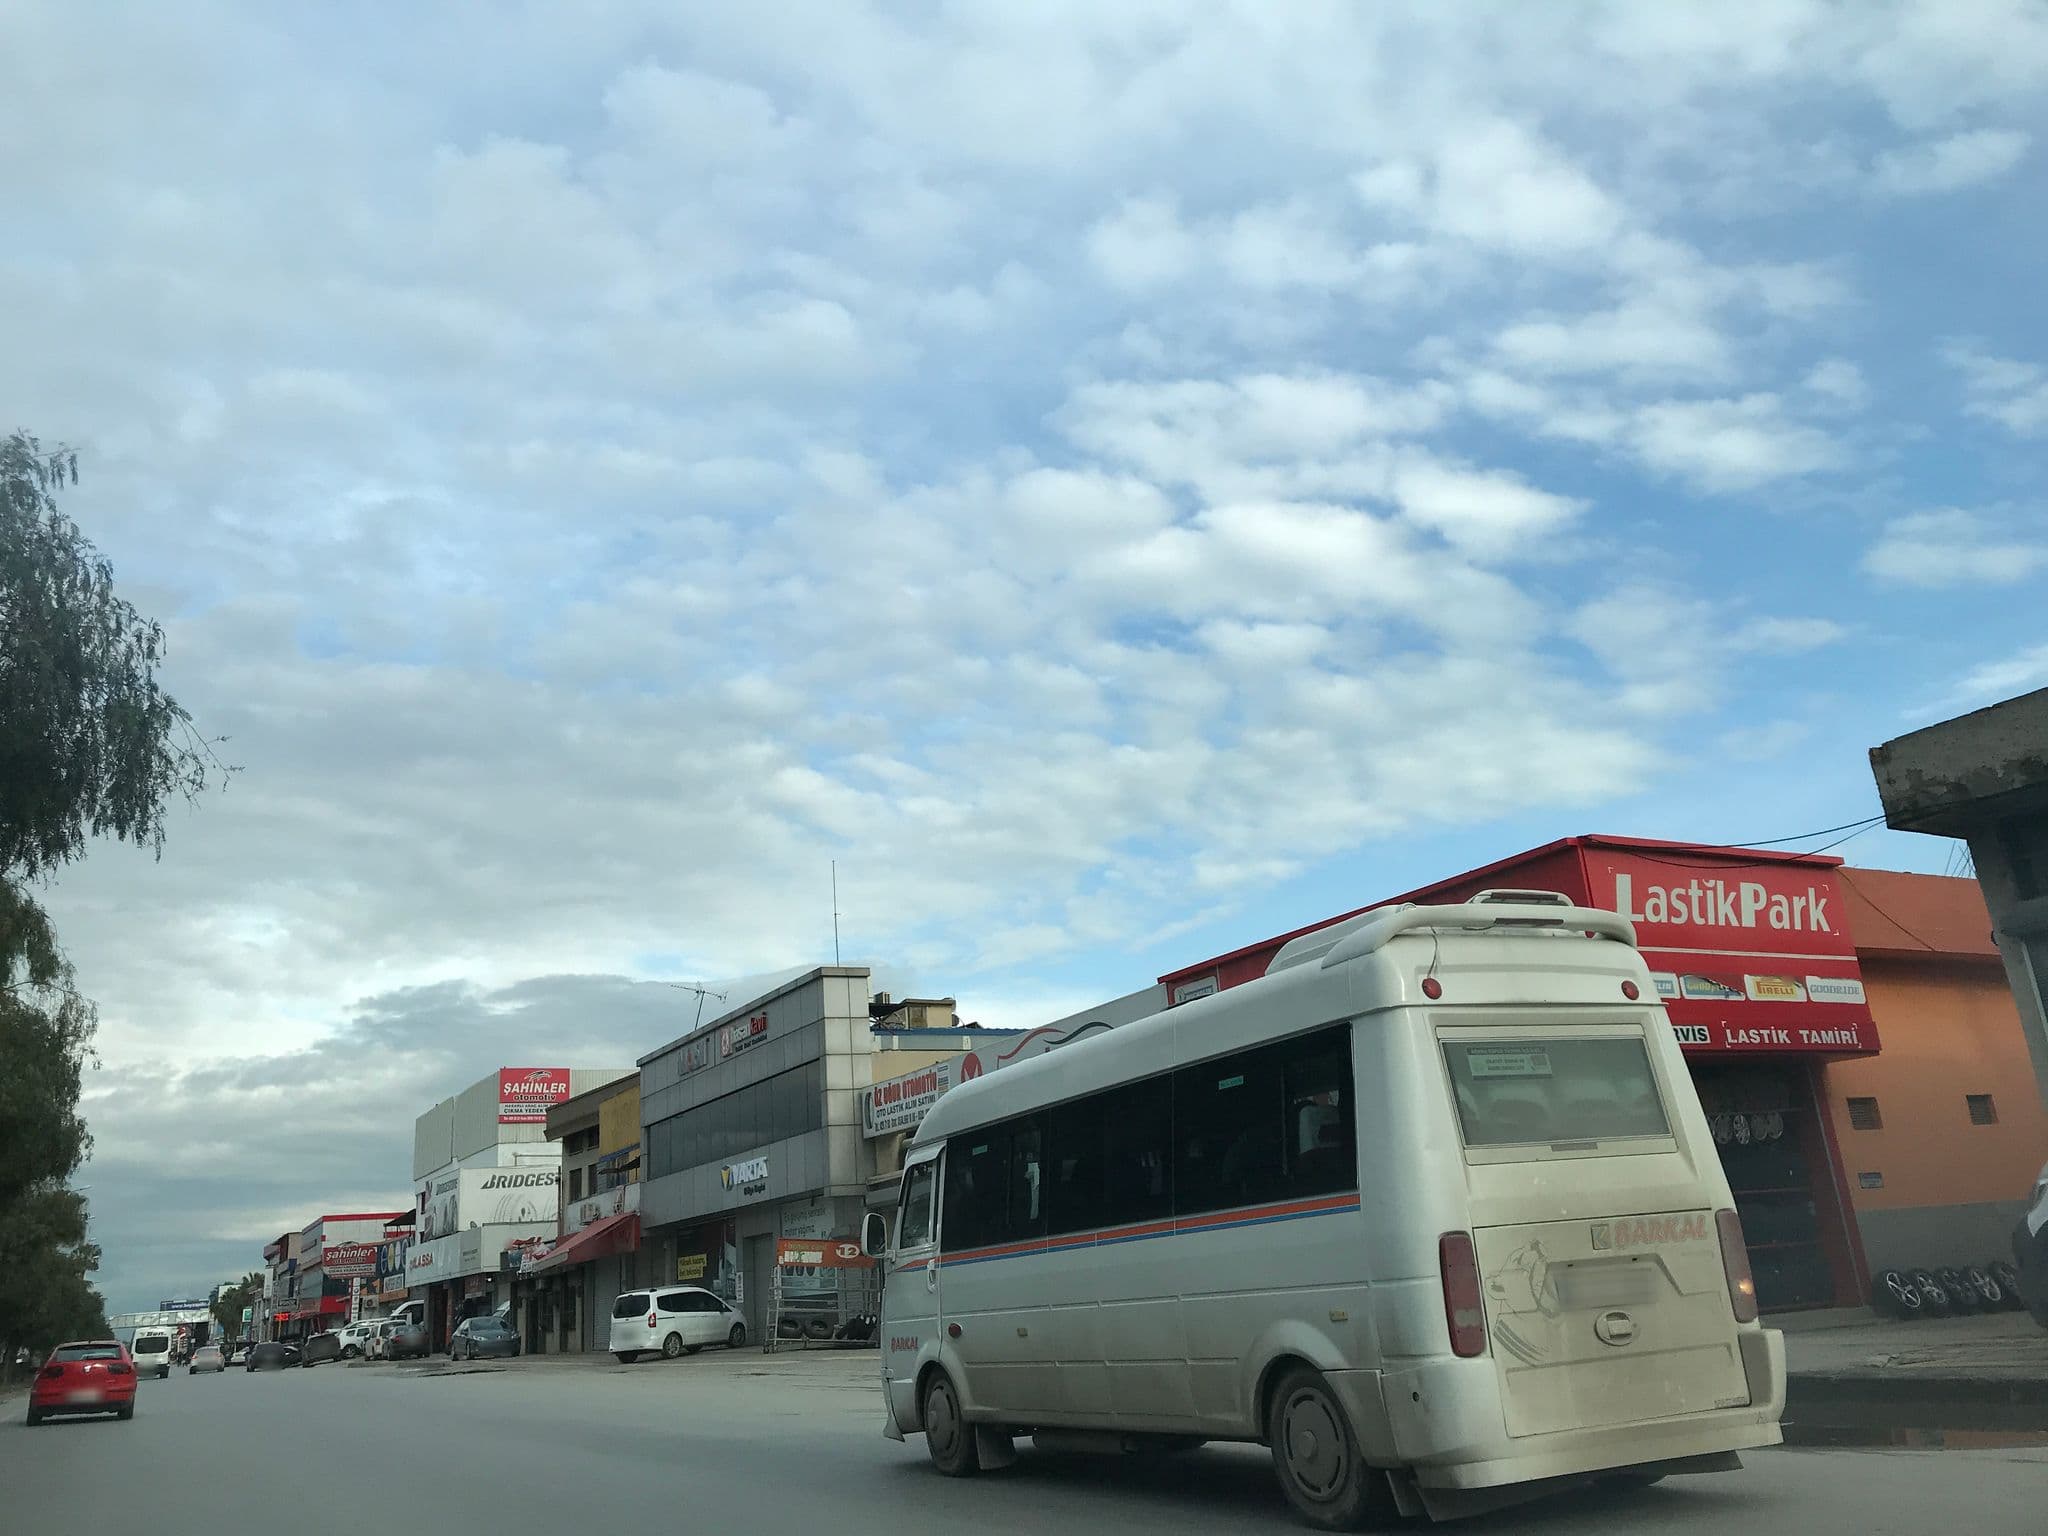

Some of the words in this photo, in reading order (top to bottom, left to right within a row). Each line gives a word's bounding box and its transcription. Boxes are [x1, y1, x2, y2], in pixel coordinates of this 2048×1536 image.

[1810, 982, 1860, 996] GOODRIDE
[1726, 1026, 1791, 1045] LASTİK
[1799, 1026, 1858, 1045] TAMİRİ
[503, 1080, 566, 1096] ŞAHİNLER
[902, 1068, 937, 1100] OTOMOTİV
[876, 1108, 886, 1119] OTO
[887, 1102, 904, 1117] LASTİK
[480, 1172, 560, 1190] BRIDGES
[326, 1247, 374, 1261] şahinler
